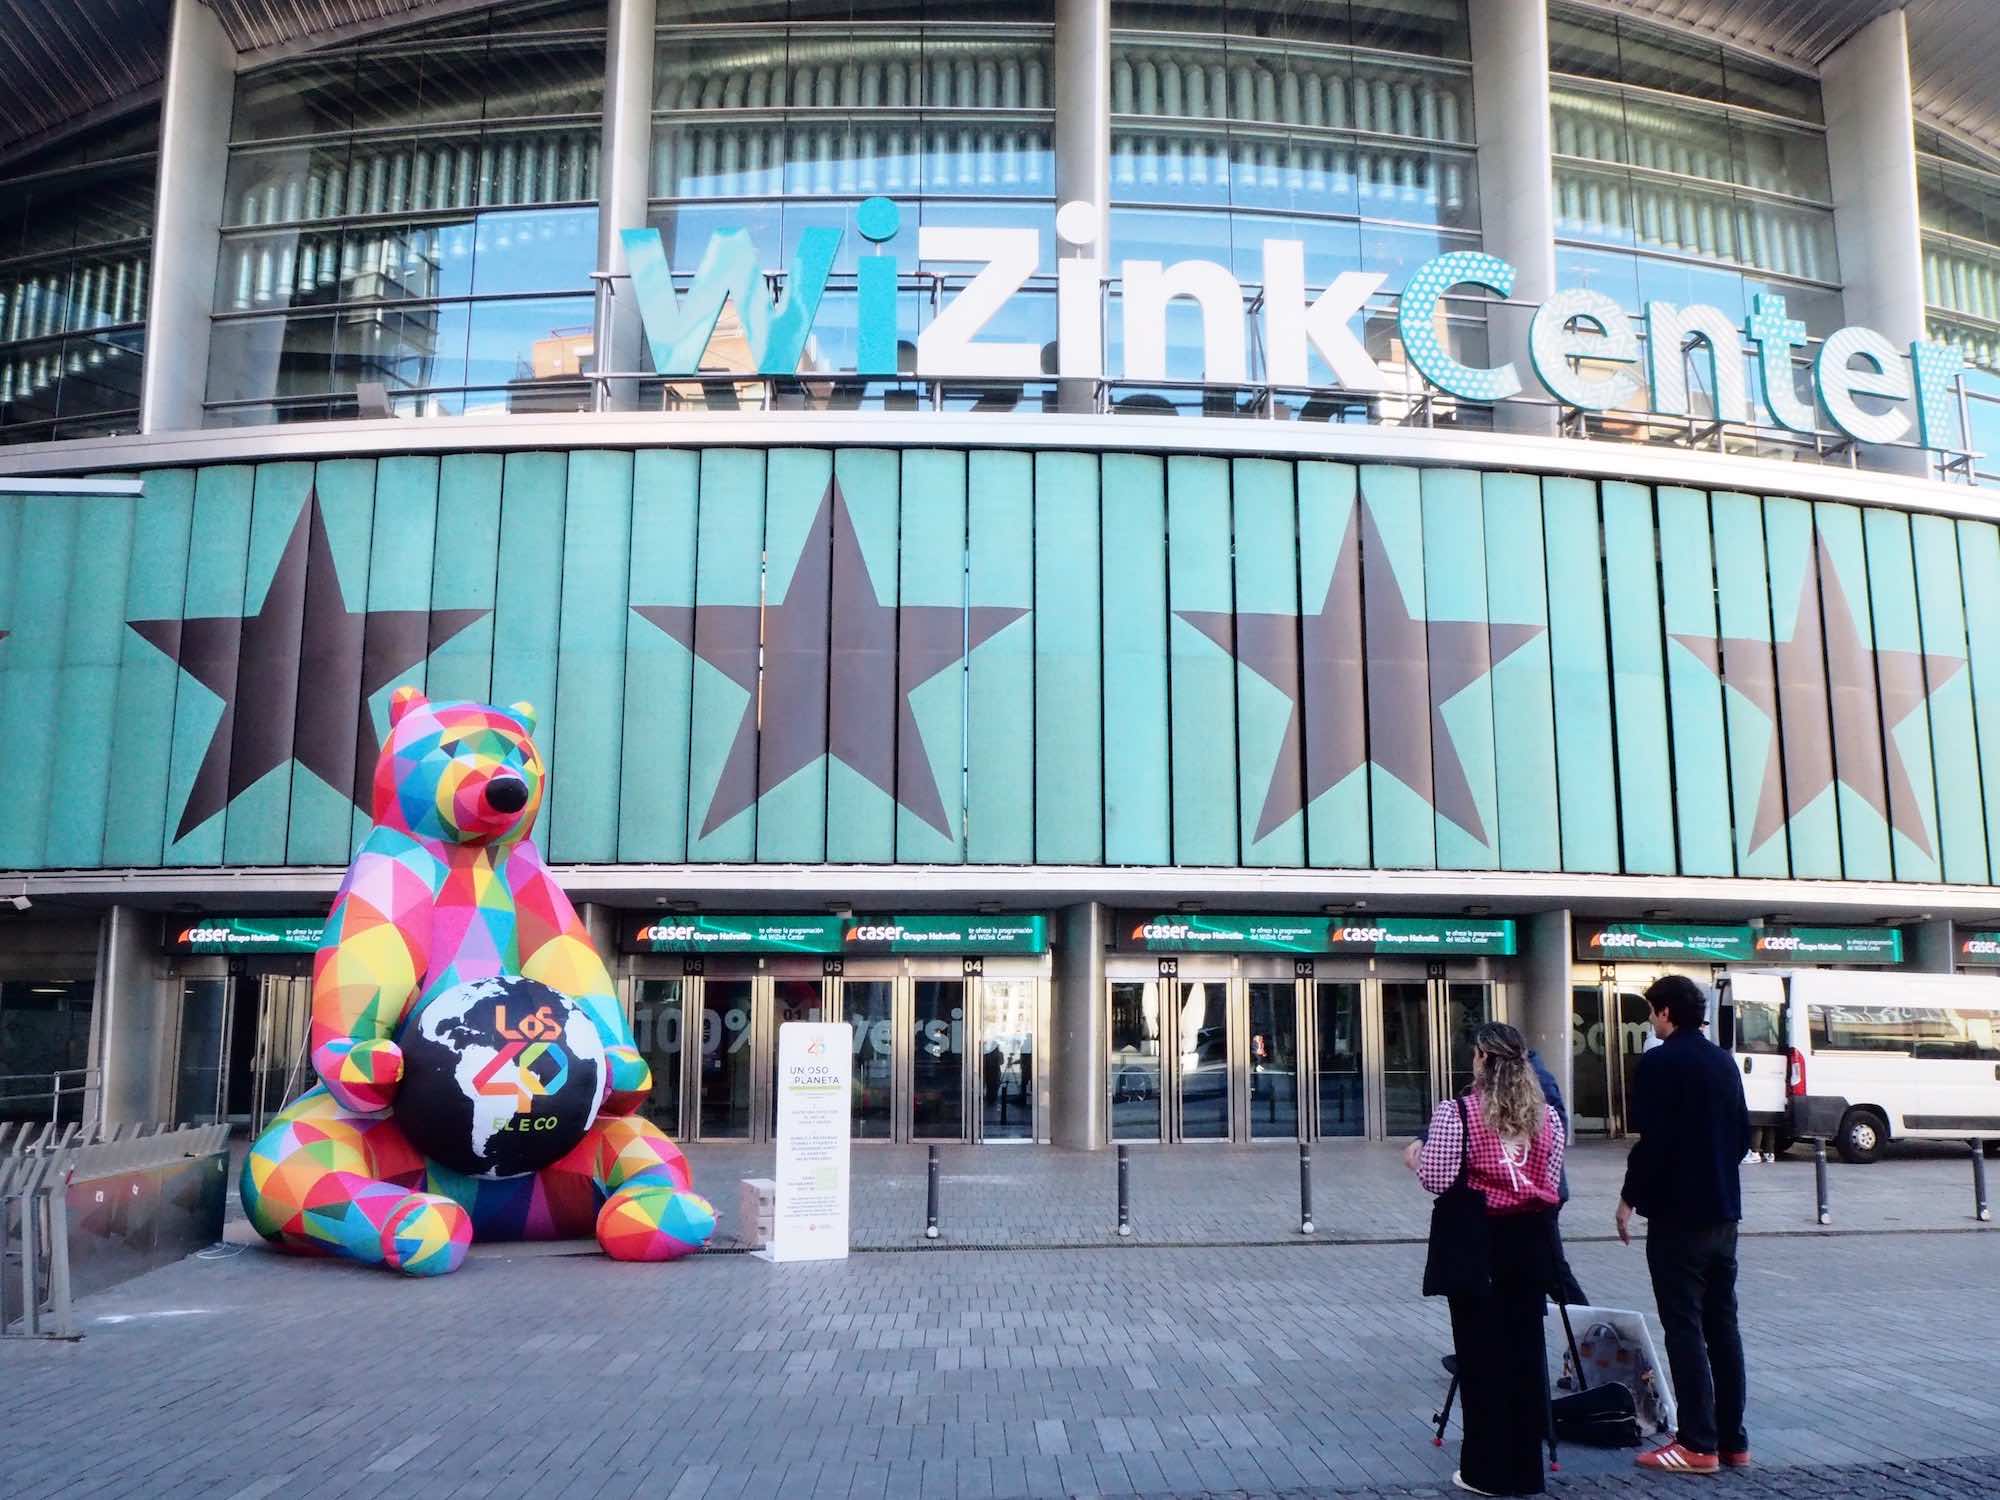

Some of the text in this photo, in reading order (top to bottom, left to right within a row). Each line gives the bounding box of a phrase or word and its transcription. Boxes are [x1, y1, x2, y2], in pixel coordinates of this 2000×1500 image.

[620, 196, 1965, 450] WiZink Center
[188, 928, 230, 942] caser
[648, 926, 695, 940] caser
[694, 933, 718, 942] Grupo
[856, 926, 961, 942] caser Grupo Helvetia
[1143, 925, 1188, 939] caser
[1187, 932, 1211, 941] Grupo
[1342, 927, 1387, 941] caser
[1386, 934, 1408, 943] Grupo
[1600, 933, 1637, 947] caser
[1764, 937, 1800, 950] caser
[1968, 941, 1997, 953] caser
[686, 960, 702, 971] 06
[825, 960, 842, 972] 05
[965, 960, 982, 973] 04
[1160, 962, 1176, 974] 03
[1296, 963, 1312, 974] 02
[1601, 965, 1614, 977] 76
[472, 1041, 568, 1113] 40
[789, 1066, 829, 1075] UN OSO
[794, 1076, 840, 1085] PLANETA
[491, 1116, 558, 1132] EL ECO
